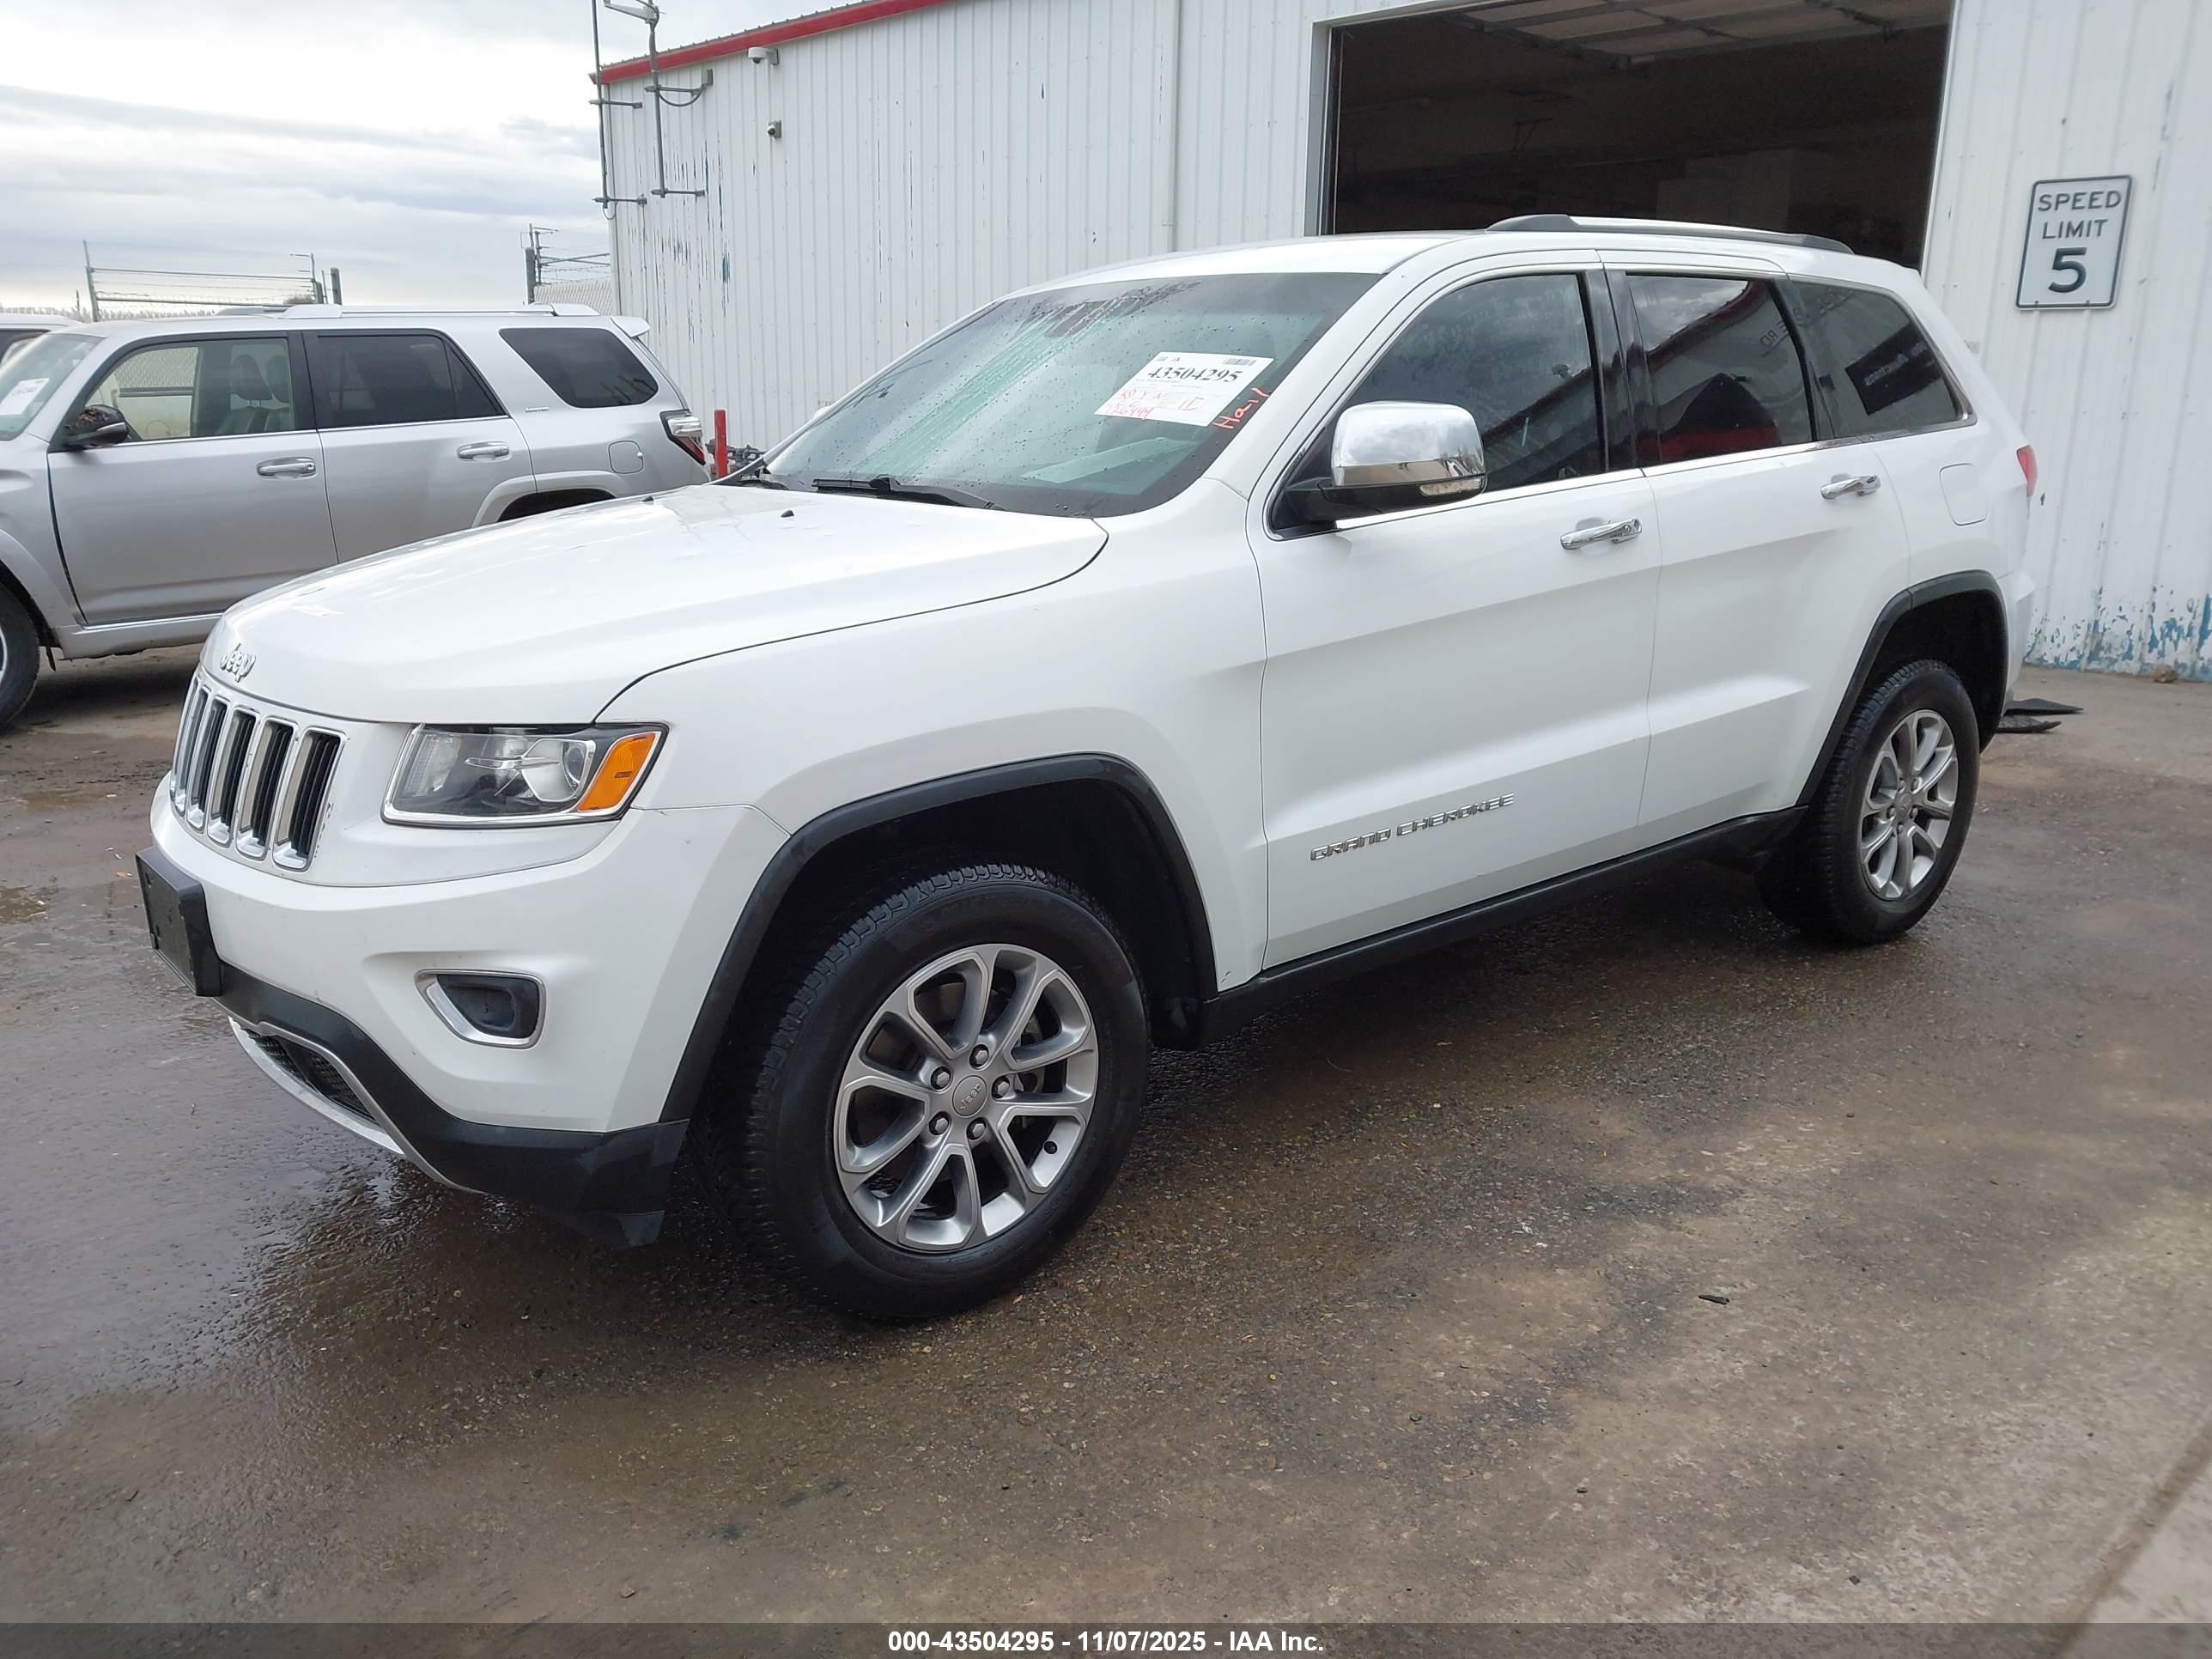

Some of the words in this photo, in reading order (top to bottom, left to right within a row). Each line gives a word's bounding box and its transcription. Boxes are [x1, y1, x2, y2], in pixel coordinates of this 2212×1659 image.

[2038, 190, 2122, 212] SPEED
[2042, 219, 2108, 239] LIMIT
[2048, 246, 2087, 293] 5
[1147, 367, 1243, 383] 43504295
[220, 644, 256, 683] Jeep
[1310, 828, 1391, 860] GRAND
[1397, 793, 1515, 836] CHEROKEE
